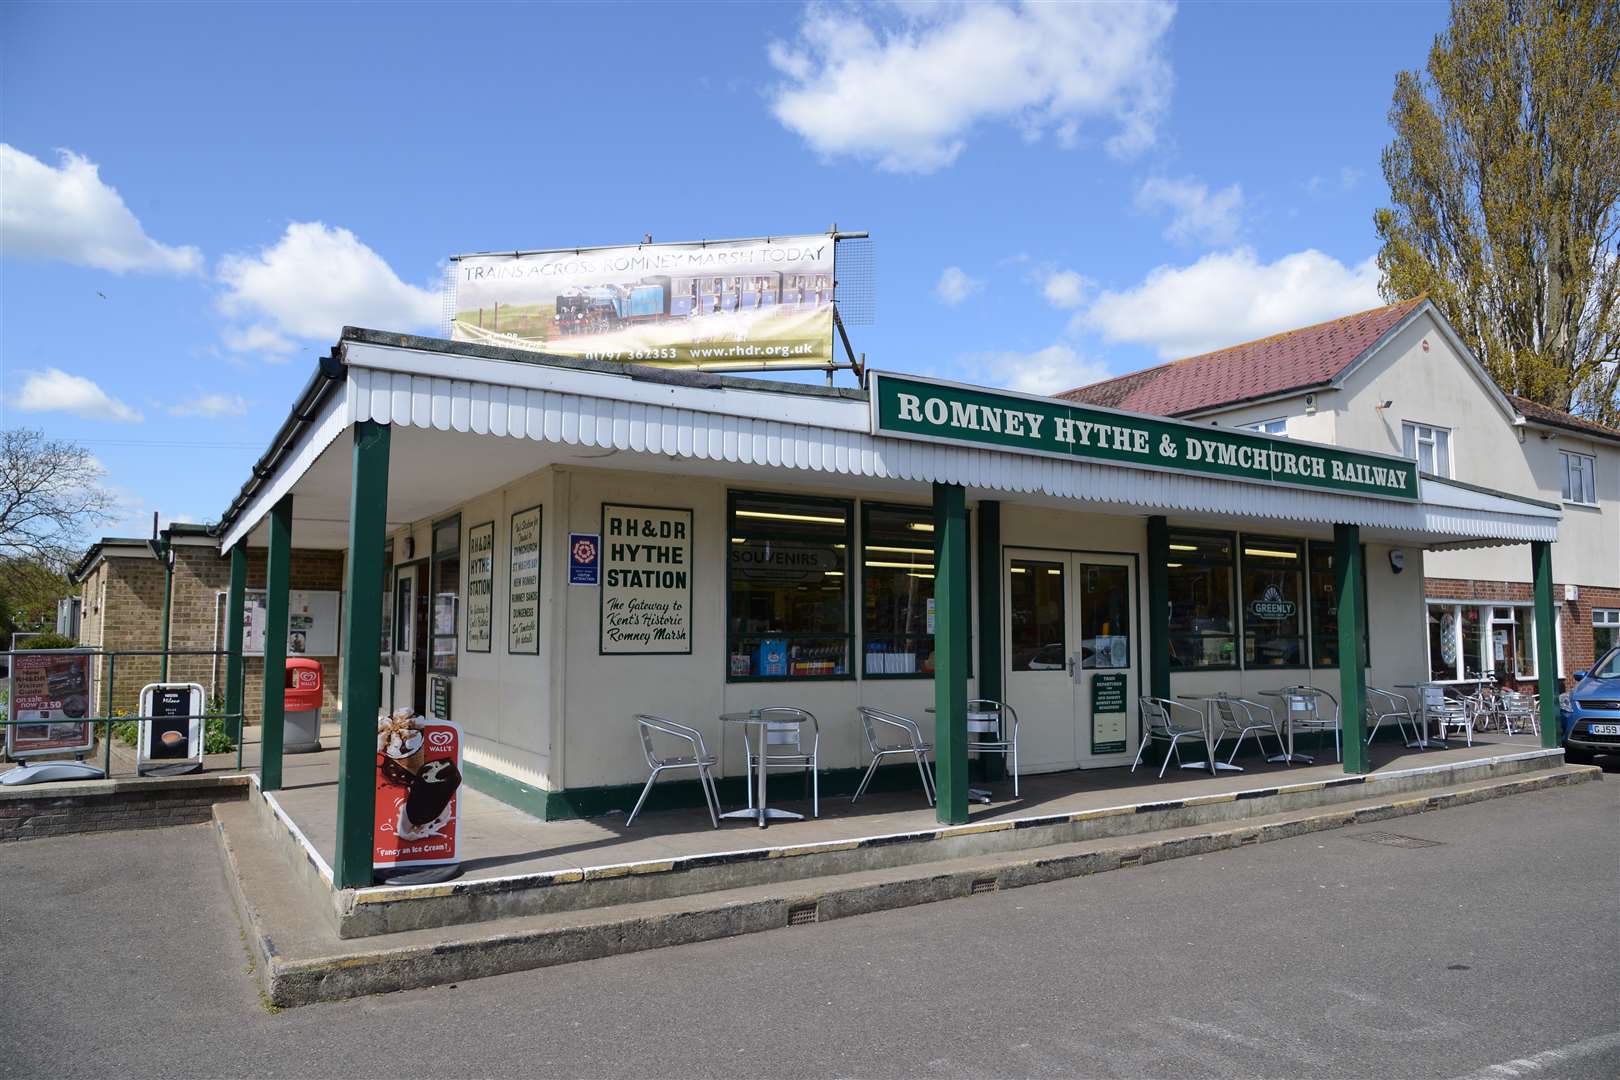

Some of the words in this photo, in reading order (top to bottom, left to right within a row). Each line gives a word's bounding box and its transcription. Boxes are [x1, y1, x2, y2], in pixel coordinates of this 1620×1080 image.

[464, 264, 524, 281] TRAINS
[529, 260, 596, 277] ACROSS
[603, 254, 683, 271] ROMNEY
[688, 251, 753, 266] MARSH
[761, 246, 825, 262] TODAY
[628, 348, 677, 360] 362353
[689, 343, 813, 358] www.rhdr.org.uk
[897, 393, 1045, 438] ROMNEY
[1054, 417, 1150, 454] HYTHE
[1159, 433, 1178, 458] &
[1185, 437, 1327, 478] DYMCHURCH
[1331, 460, 1407, 489] RAILWAY
[611, 543, 683, 564] HYTHE
[731, 550, 818, 566] SOUVENIRS
[470, 557, 490, 576] HYTHE
[469, 579, 491, 597] STATION
[607, 569, 687, 589] STATION
[607, 597, 625, 611] The
[628, 598, 669, 615] Gateway
[672, 600, 683, 611] to
[1255, 603, 1292, 613] GREENLY
[606, 612, 640, 626] Kent's
[642, 612, 683, 627] Historic
[606, 627, 650, 645] Romney
[653, 627, 687, 641] Marsh
[1594, 725, 1617, 734] GJ59
[380, 848, 401, 857] Fancy
[423, 843, 448, 852] Cream?
